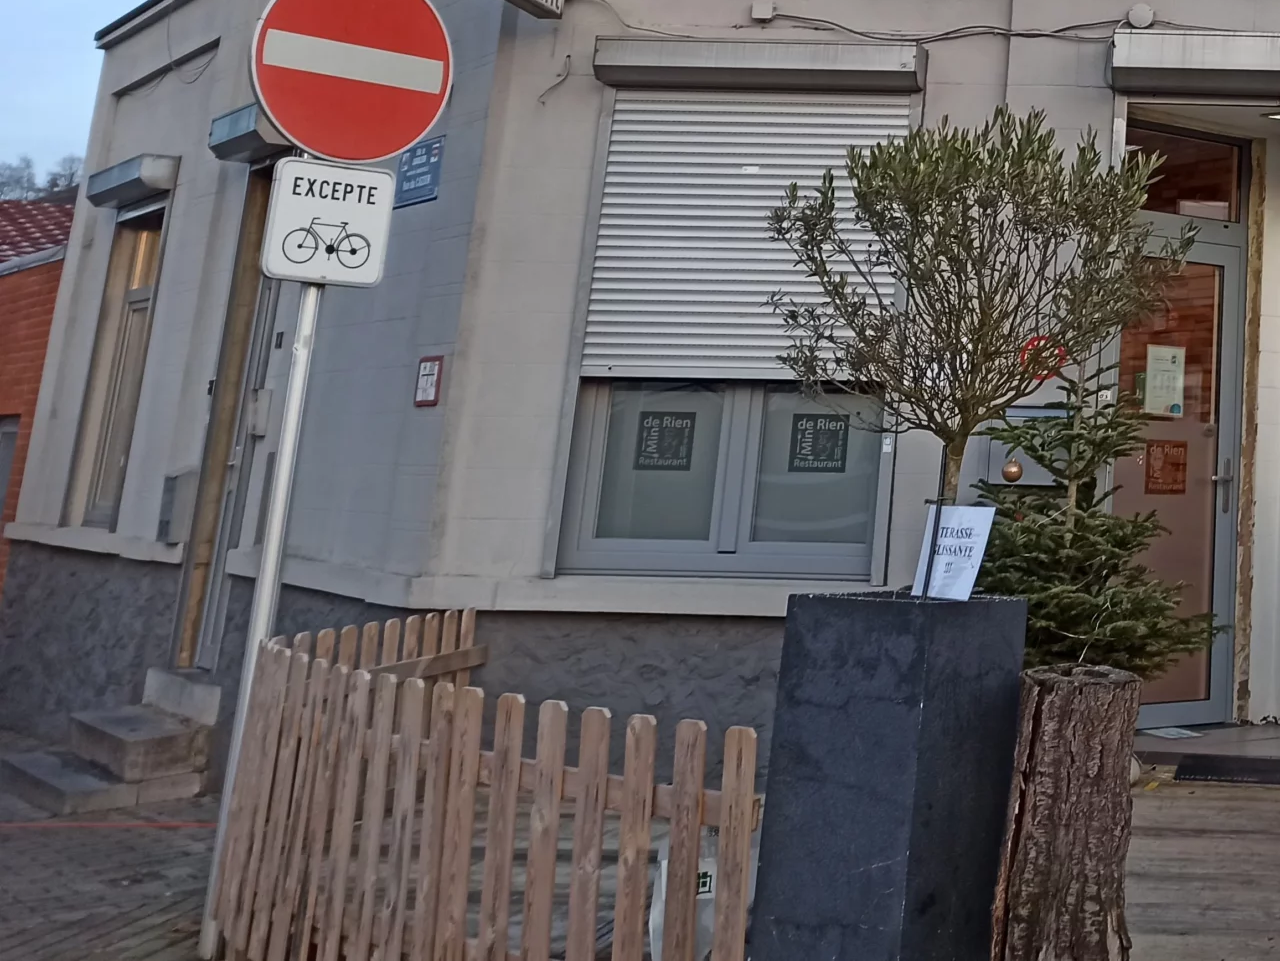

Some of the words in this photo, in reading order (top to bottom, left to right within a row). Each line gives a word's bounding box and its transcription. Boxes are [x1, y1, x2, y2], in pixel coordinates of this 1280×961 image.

[292, 176, 378, 205] EXCEPTE
[643, 415, 660, 428] de
[662, 416, 691, 428] Rien
[797, 417, 814, 430] de
[816, 418, 845, 430] Rien
[1164, 444, 1185, 456] Rien
[638, 456, 688, 467] Restaurant
[793, 458, 842, 468] Restaurant
[940, 526, 975, 539] TERASSE
